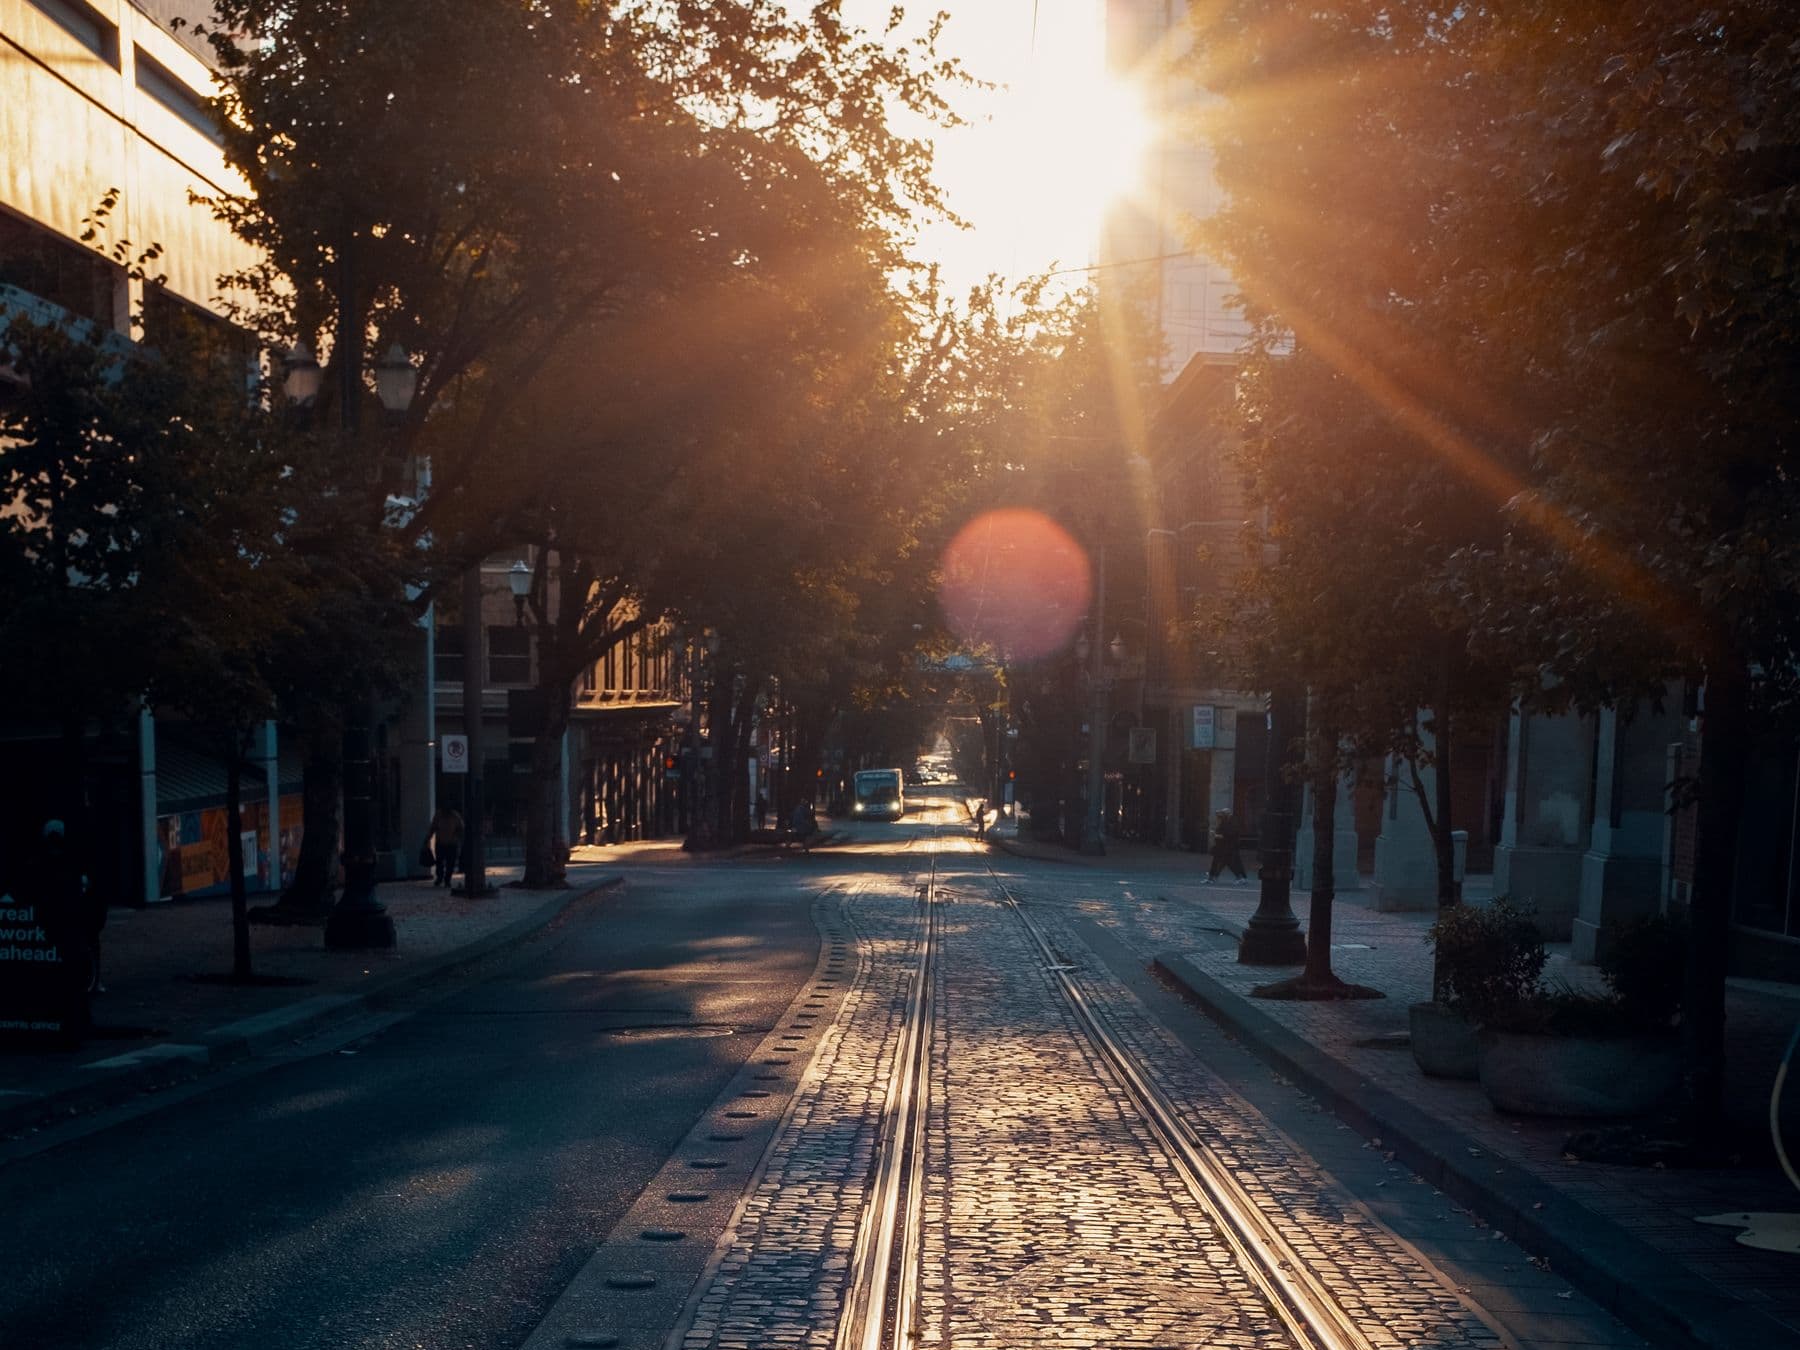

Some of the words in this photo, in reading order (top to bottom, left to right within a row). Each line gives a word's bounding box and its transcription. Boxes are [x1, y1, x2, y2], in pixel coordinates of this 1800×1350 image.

[0, 904, 34, 921] real
[0, 926, 46, 942] work
[0, 945, 63, 963] ahead.
